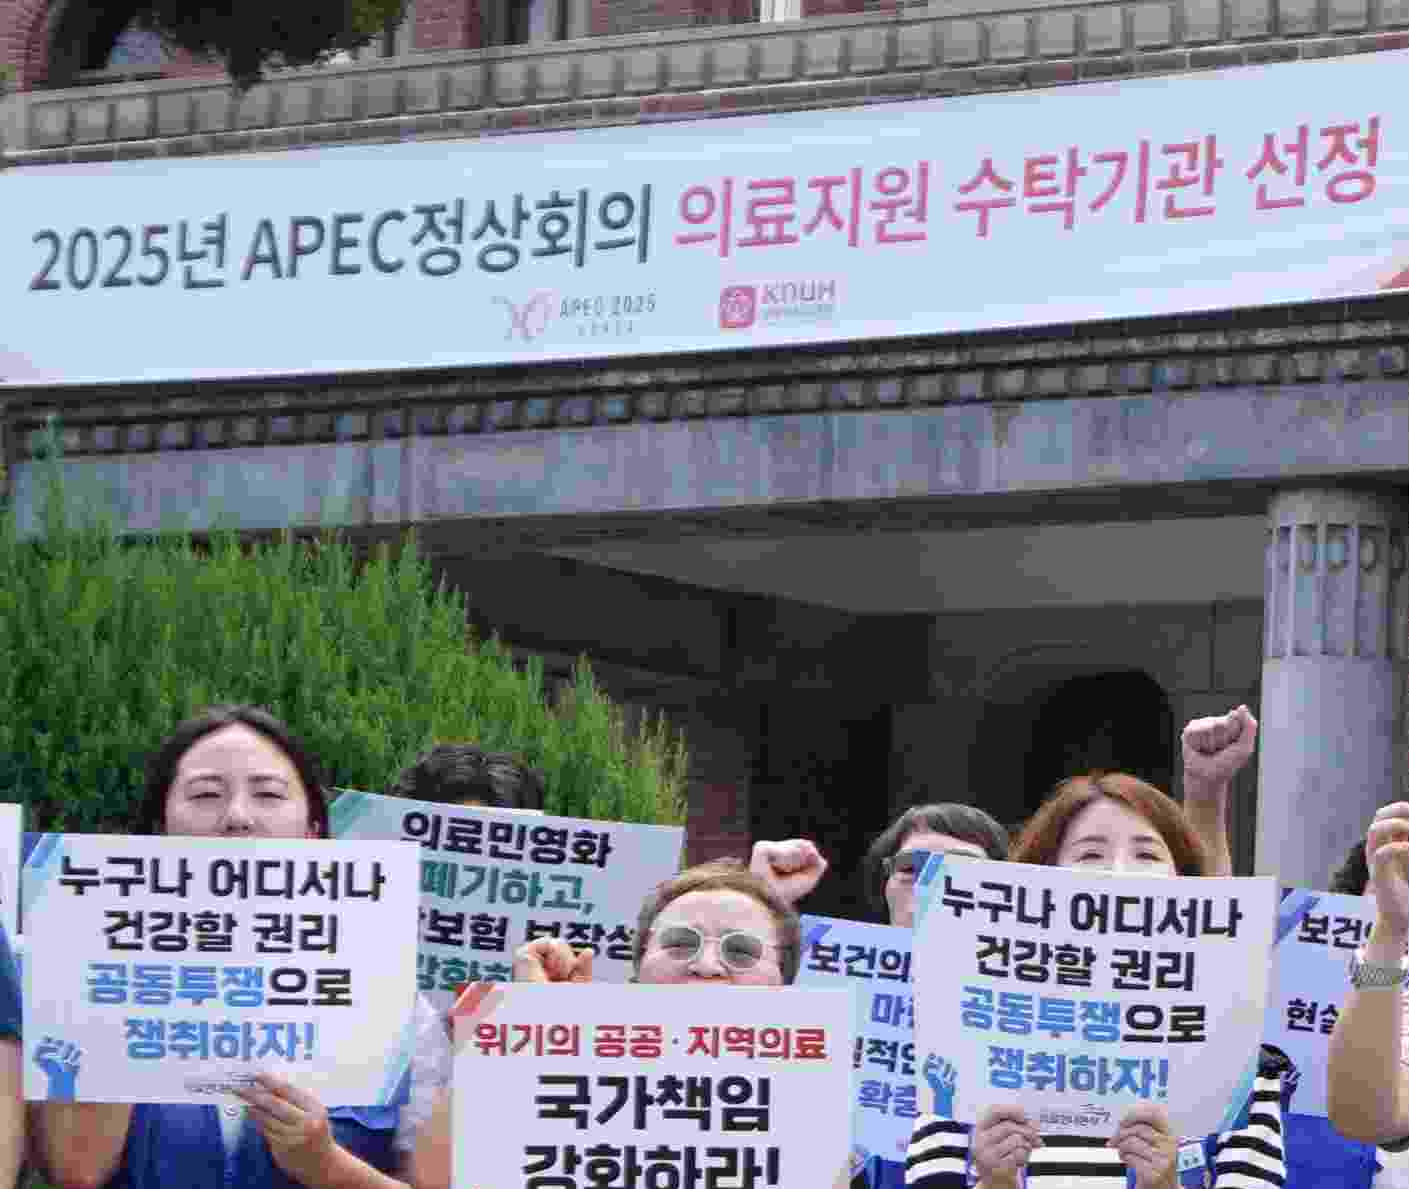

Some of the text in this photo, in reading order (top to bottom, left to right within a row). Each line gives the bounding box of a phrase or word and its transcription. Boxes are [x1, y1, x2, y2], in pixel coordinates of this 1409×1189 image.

[29, 116, 1382, 290] 2025년 APEC정상회의 의료지원 수탁기관 선정
[400, 812, 614, 867] 의료민영화
[59, 857, 385, 902] 누구나 어디서나
[103, 910, 336, 953] 건강할 권리
[419, 906, 509, 952] 보험
[941, 874, 1242, 939] 누구나 어디서나
[1298, 912, 1373, 949] 보건
[87, 963, 351, 1010] 공동투쟁으로
[975, 934, 1195, 992] 건강할 권리
[123, 1019, 315, 1062] 쟁취하자!
[959, 984, 1207, 1046] 공동투쟁으로
[473, 1024, 580, 1058] 위기의
[593, 1026, 662, 1058] 공공
[688, 1026, 829, 1061] 지역의료
[987, 1045, 1169, 1101] 쟁취하자!
[534, 1074, 770, 1133] 국가책임
